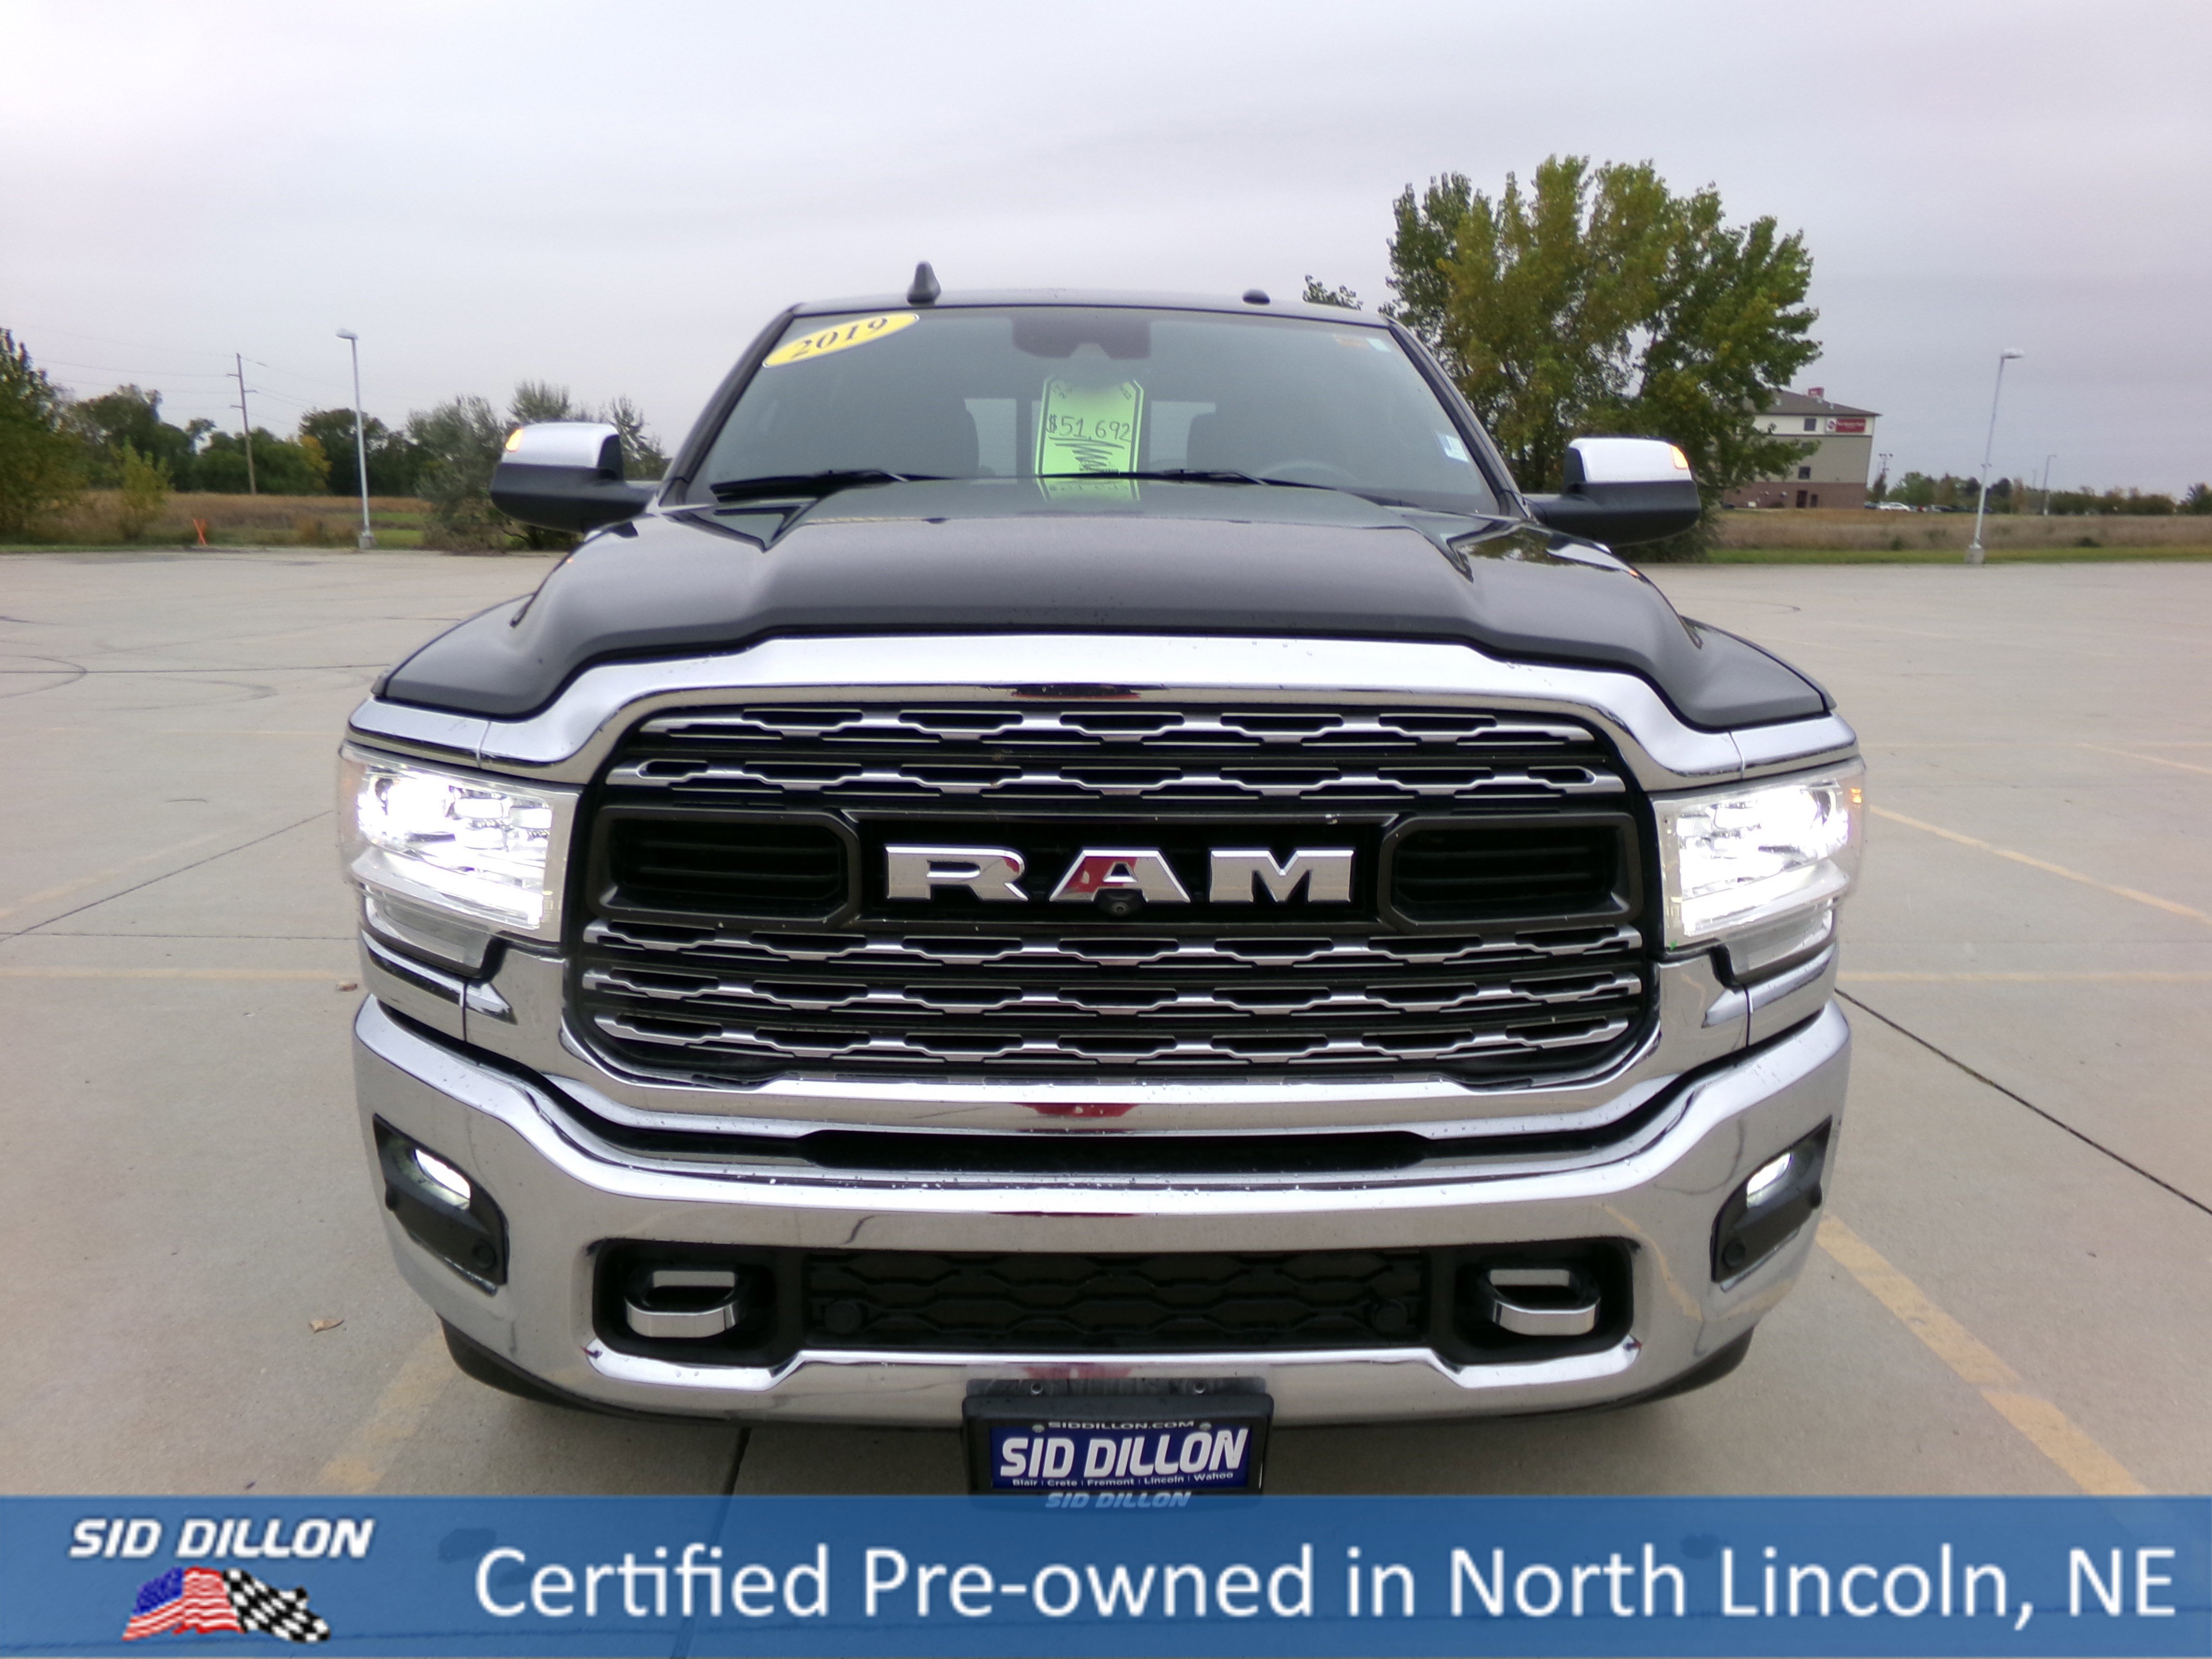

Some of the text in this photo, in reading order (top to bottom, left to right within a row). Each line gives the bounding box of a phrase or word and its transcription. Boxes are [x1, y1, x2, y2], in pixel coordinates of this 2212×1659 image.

[790, 318, 888, 359] 2019
[1046, 414, 1131, 443] $51,692
[885, 845, 1354, 902] RAM
[1048, 1420, 1194, 1430] SIDDILLON.COM
[1000, 1428, 1249, 1478] SID DILLON
[1012, 1471, 1233, 1487] Blair Crete Fremont Lincoln Wahoo
[1045, 1491, 1192, 1508] SID DILLON
